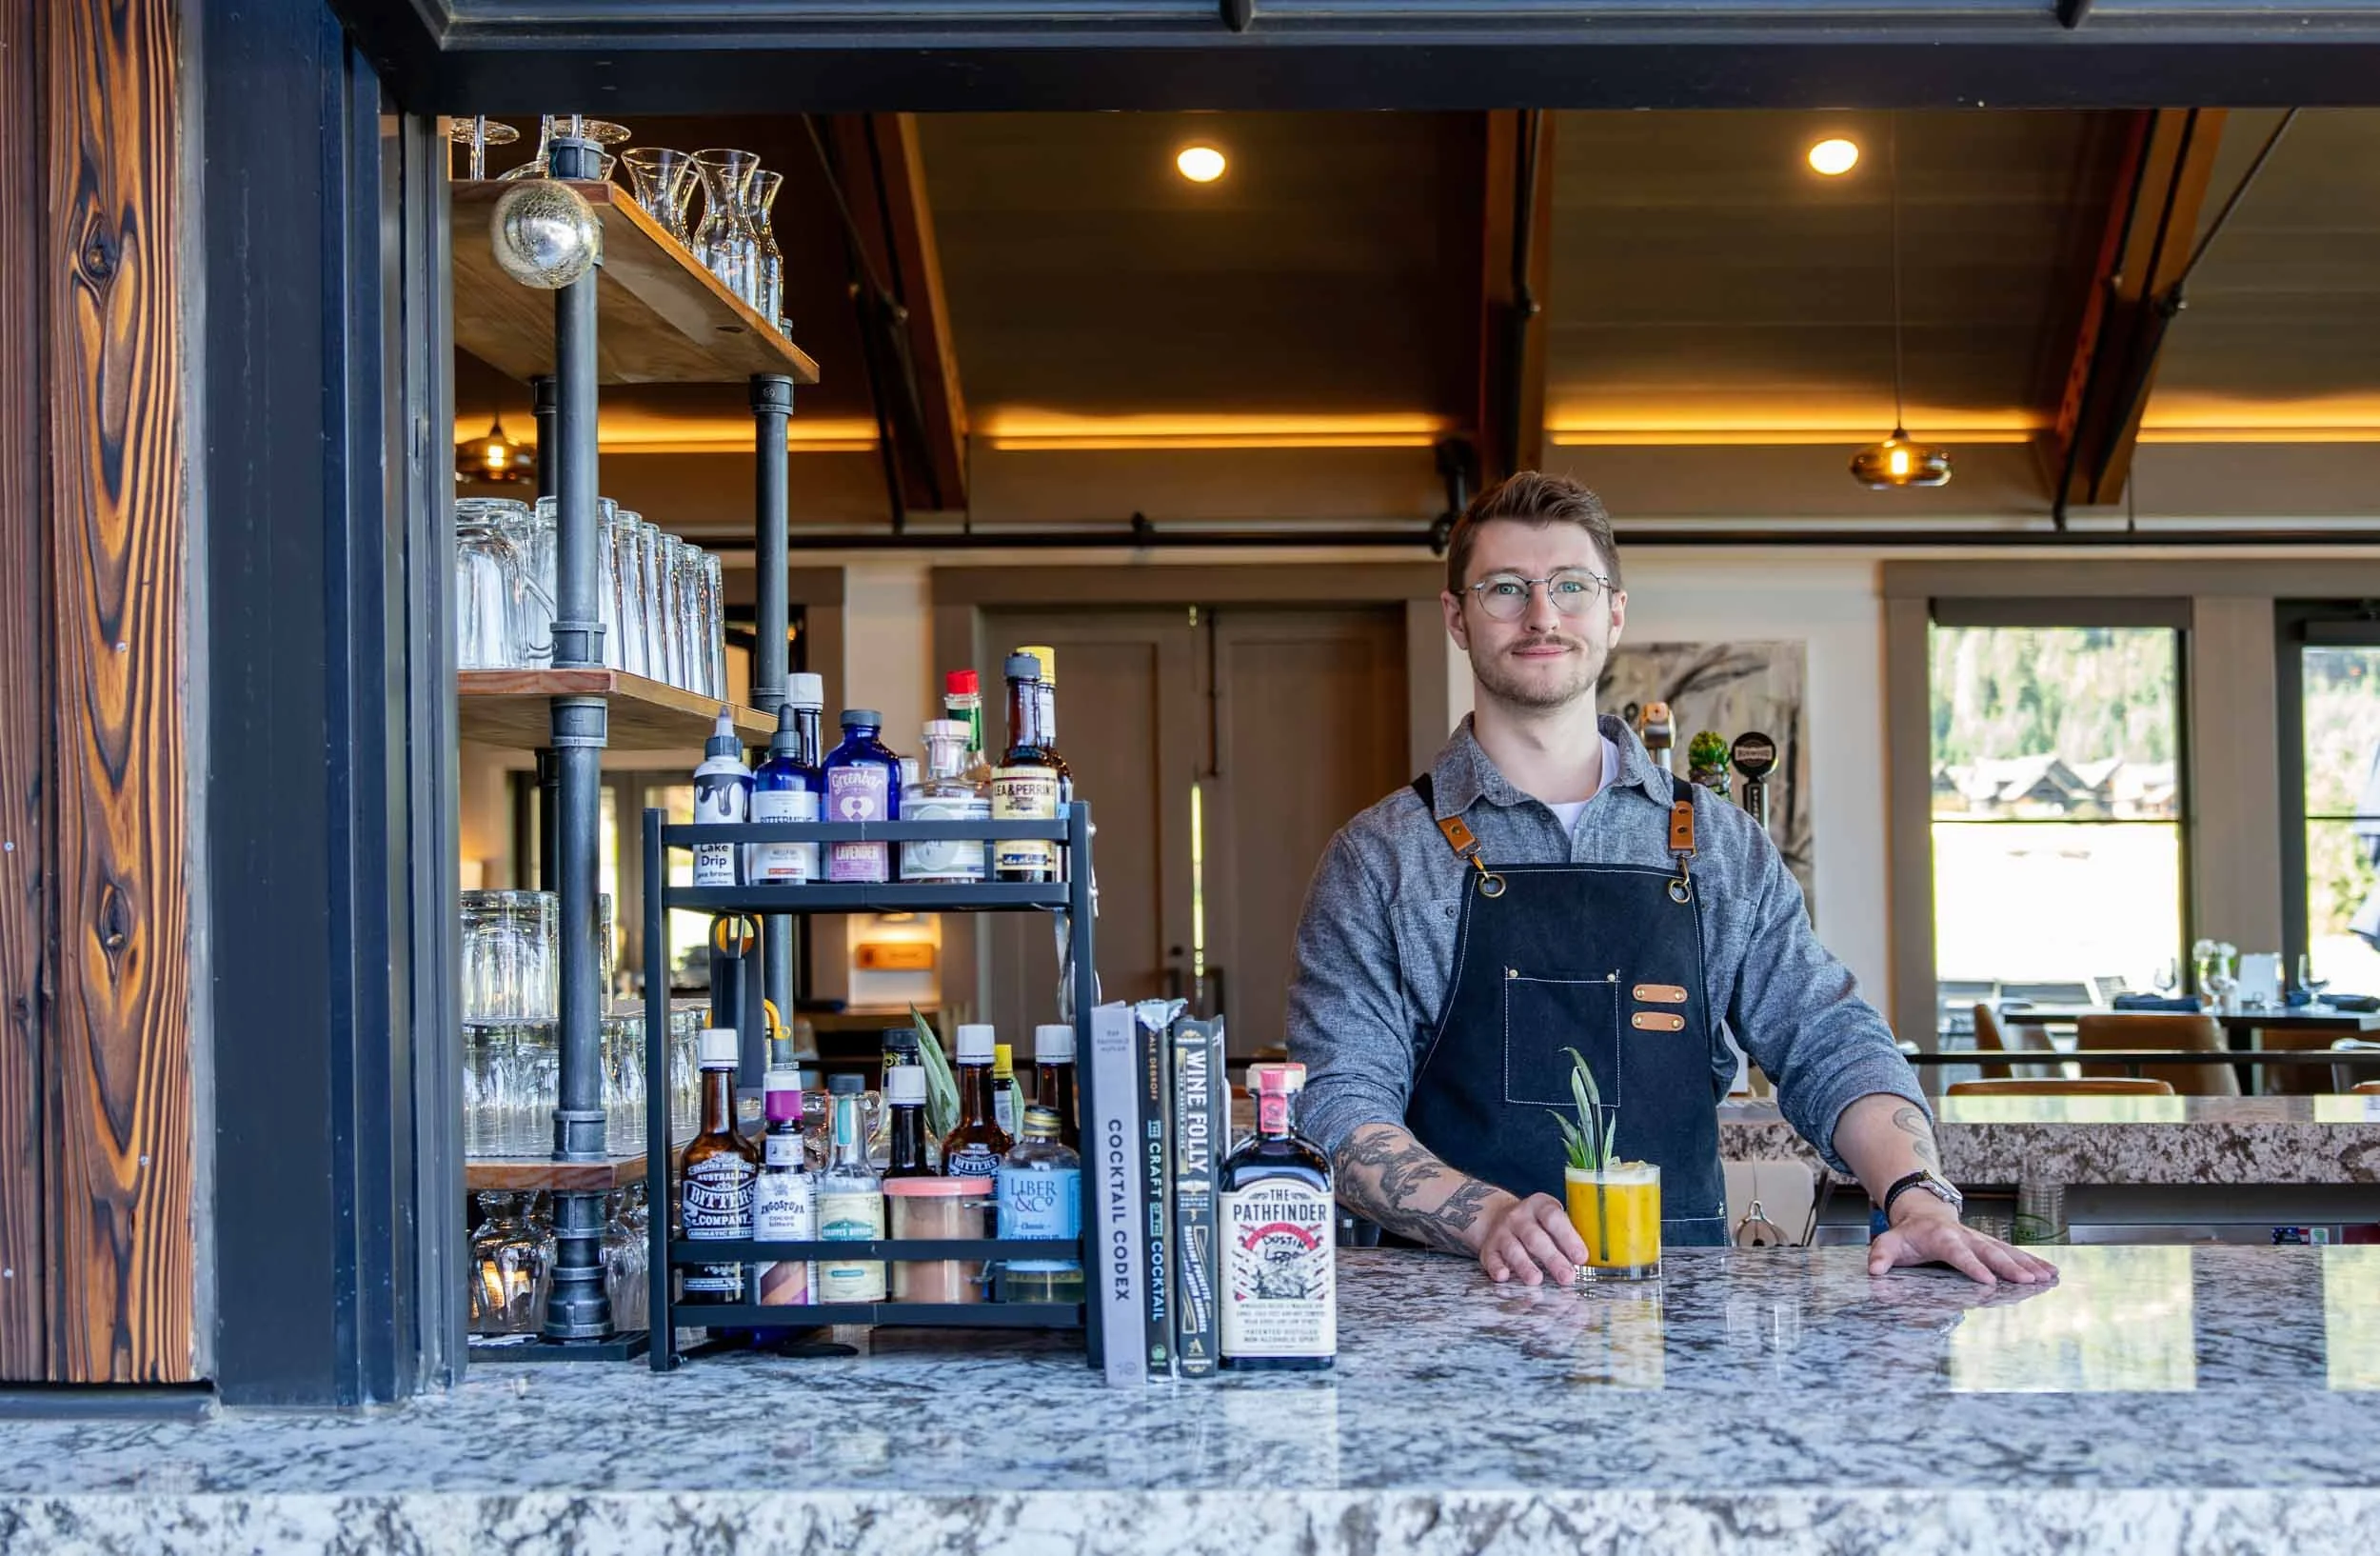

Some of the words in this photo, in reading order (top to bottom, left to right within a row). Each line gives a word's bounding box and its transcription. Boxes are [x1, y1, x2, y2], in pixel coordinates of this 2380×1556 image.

[832, 770, 883, 794] Greenbar
[701, 855, 727, 868] Drip
[1149, 1057, 1158, 1101] DEGROFF
[1187, 1049, 1207, 1106] WINE
[1187, 1112, 1208, 1173] FOLLY
[953, 1157, 999, 1171] BITTERS
[1107, 1119, 1126, 1223] COCKTAIL
[1149, 1143, 1162, 1197] CRAFT
[697, 1172, 748, 1181] AUSTRALIAN
[1010, 1177, 1058, 1196] LIBER
[690, 1184, 754, 1208] BITTERS
[1270, 1189, 1289, 1201] THE
[699, 1214, 748, 1227] COMPANY
[1234, 1204, 1326, 1222] PATHFINDER
[1112, 1230, 1130, 1302] CODEX
[1150, 1241, 1165, 1321] COCKTAIL
